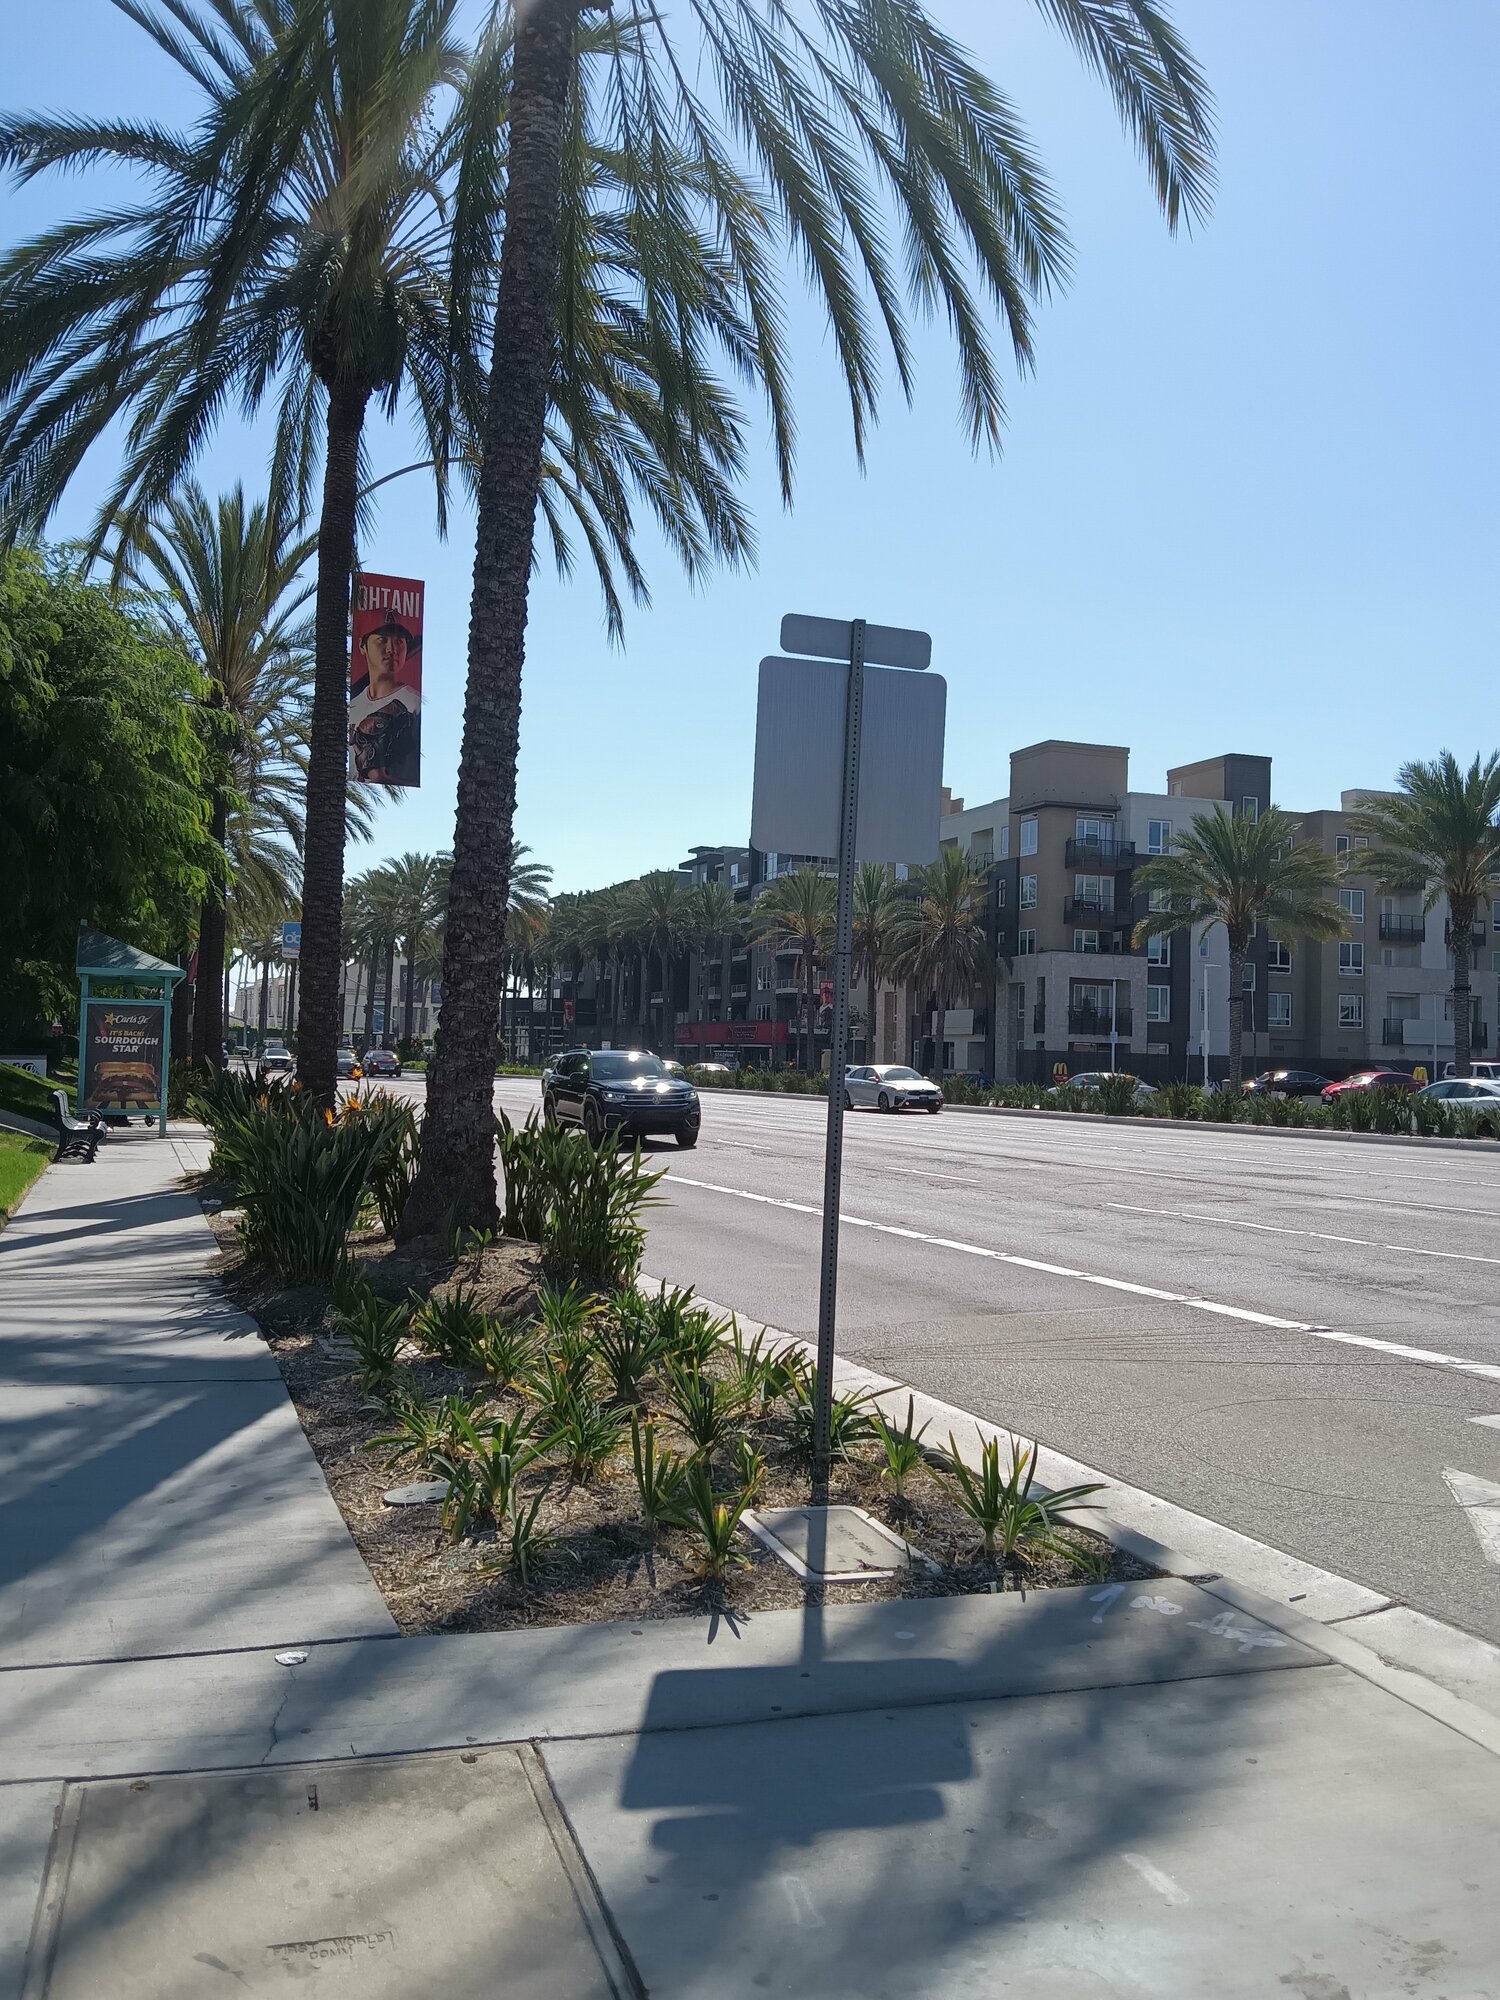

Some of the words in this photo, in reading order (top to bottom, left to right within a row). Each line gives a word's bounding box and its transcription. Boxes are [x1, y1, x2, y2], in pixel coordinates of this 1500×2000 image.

[115, 1014, 137, 1024] Carl's
[94, 1036, 159, 1046] SOURDOUGH
[112, 1045, 139, 1053] STAR
[272, 1941, 318, 1956] FIRST
[332, 1934, 386, 1947] WORLD
